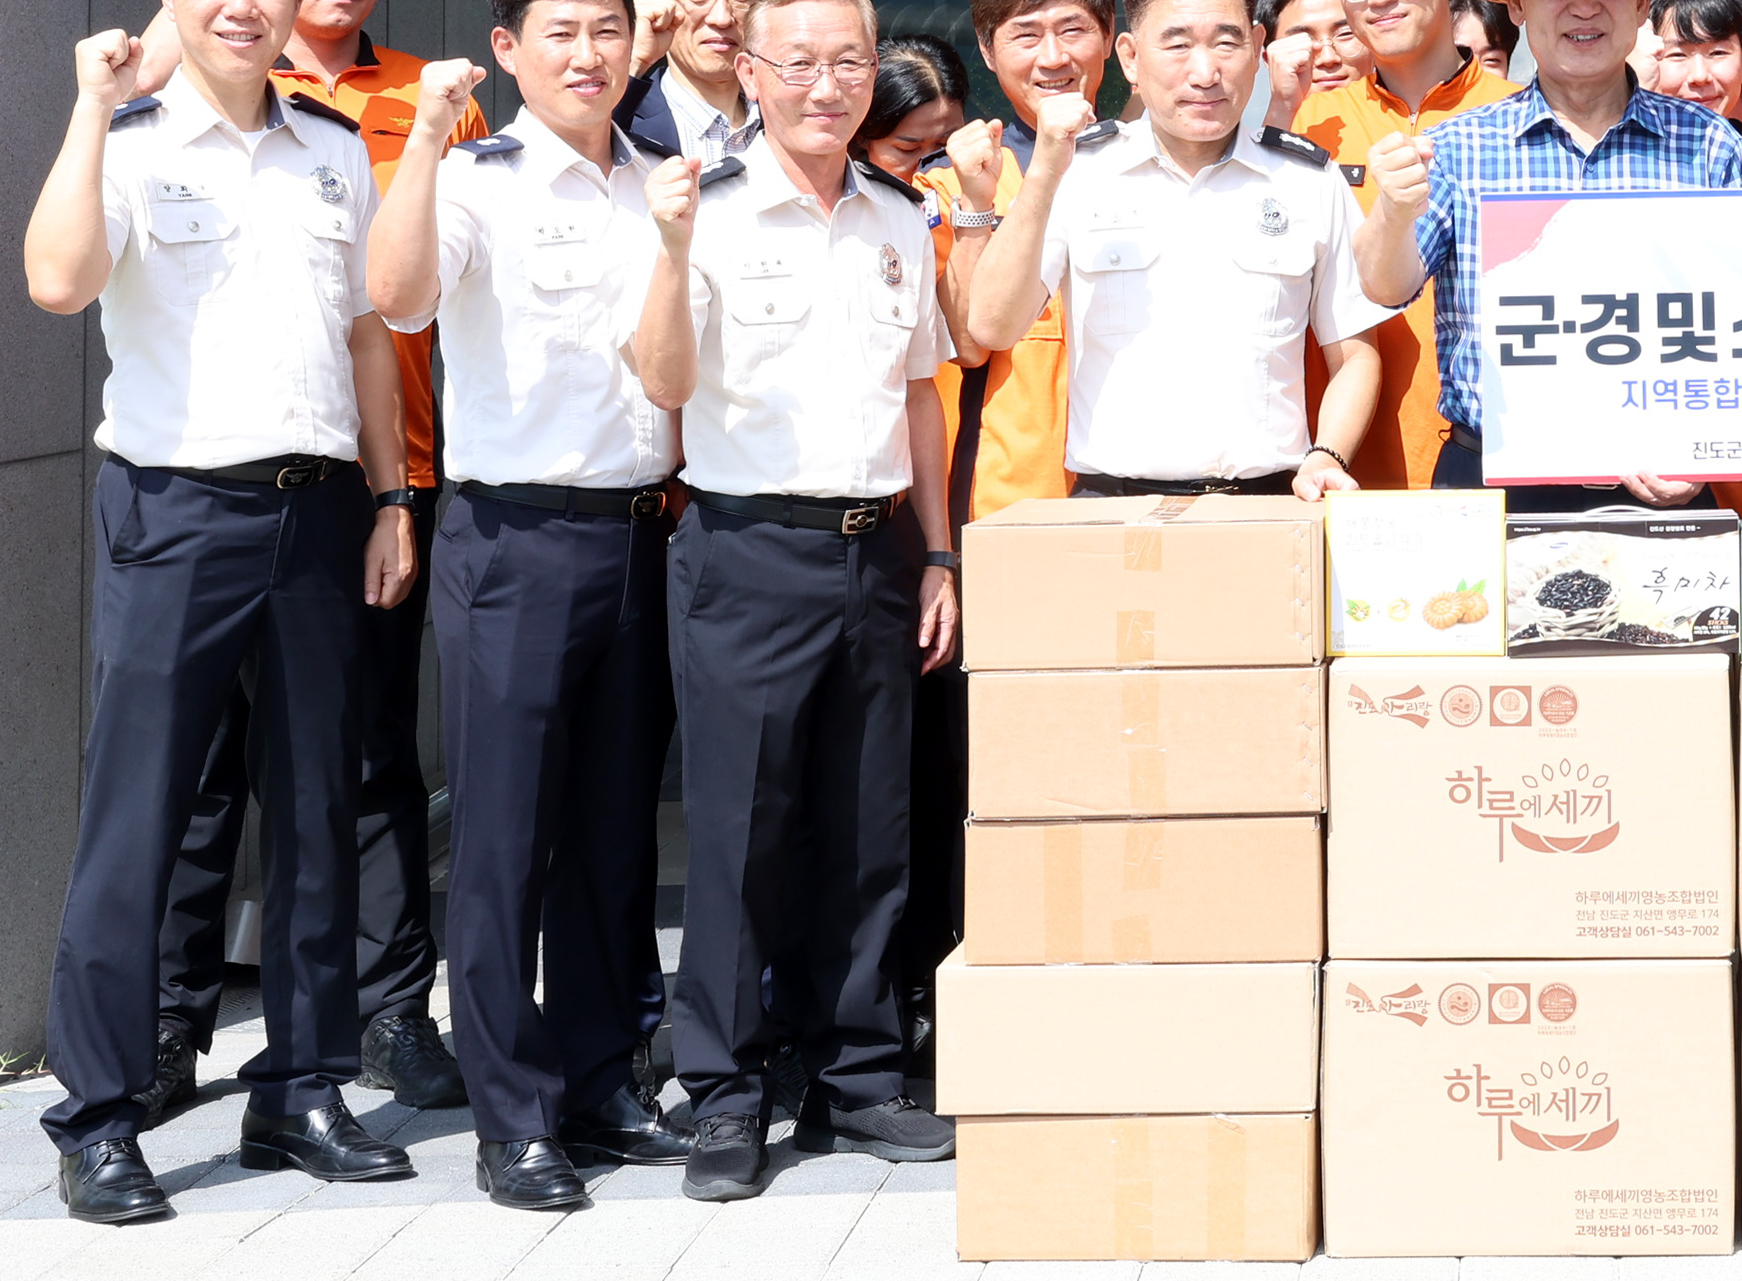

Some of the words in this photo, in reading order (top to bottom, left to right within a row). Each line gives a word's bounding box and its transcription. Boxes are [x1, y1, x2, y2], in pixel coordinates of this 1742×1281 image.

[1496, 293, 1641, 366] 군·경
[1657, 292, 1717, 363] 및
[1694, 442, 1741, 459] 진도군
[1641, 567, 1731, 604] 흑미차
[1709, 607, 1730, 621] 42
[1445, 766, 1612, 862] 하루에세끼
[1576, 890, 1718, 904] 하루에세끼영농조합법인
[1576, 910, 1595, 921] 전남
[1600, 910, 1629, 920] 진도군
[1633, 909, 1663, 920] 지산면
[1702, 909, 1719, 918] 174
[1576, 926, 1631, 938] 고객상담실
[1636, 926, 1719, 936] 061-543-7002
[1443, 1064, 1611, 1161] 하루에세끼
[1575, 1189, 1717, 1203] 하루에세끼영농조합법인
[1575, 1209, 1595, 1219] 전남
[1599, 1208, 1628, 1219] 진도군
[1633, 1208, 1662, 1219] 지산면
[1701, 1208, 1718, 1217] 174
[1575, 1225, 1630, 1237] 고객상담실
[1635, 1225, 1718, 1235] 061-543-7002
